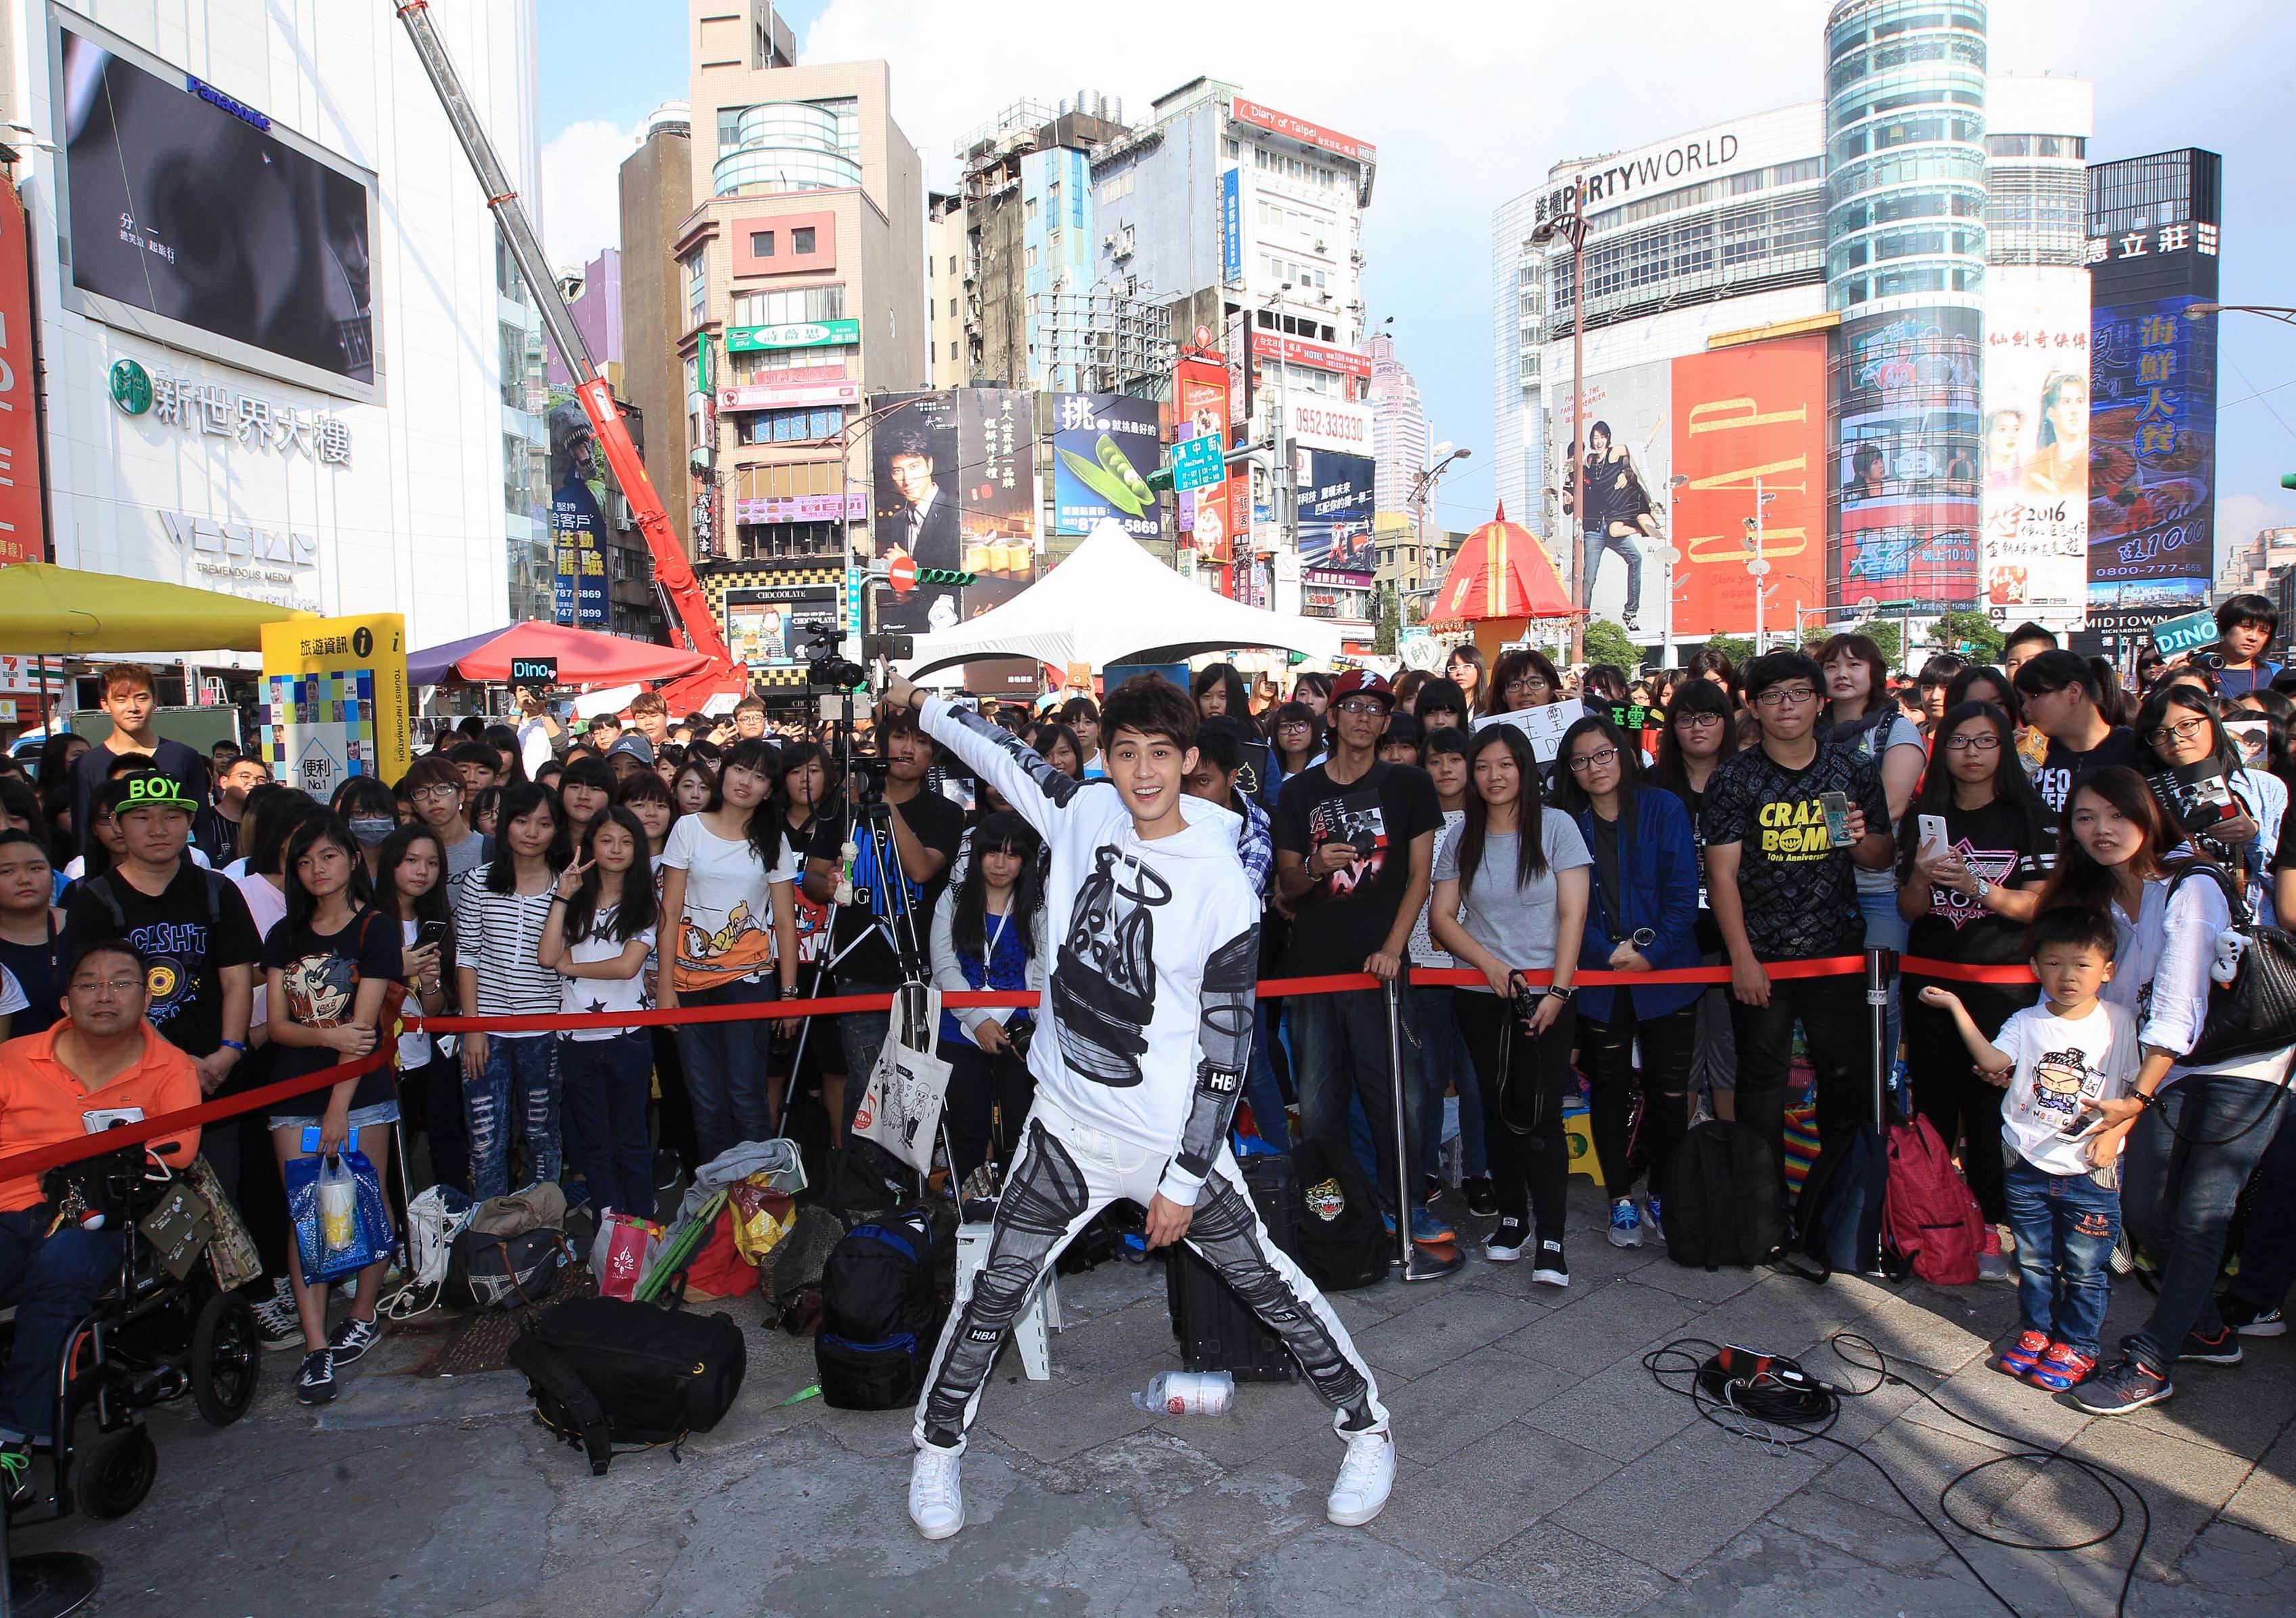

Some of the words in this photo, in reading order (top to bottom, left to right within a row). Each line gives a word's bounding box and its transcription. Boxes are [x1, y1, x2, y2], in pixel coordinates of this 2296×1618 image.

[187, 73, 271, 132] Panasonic
[1250, 104, 1276, 124] Diary
[1278, 117, 1288, 128] of
[1289, 118, 1317, 138] Taipei
[120, 212, 133, 230] 分
[2084, 224, 2190, 264] 德立莊
[1304, 349, 1324, 361] HOTEL
[1589, 385, 1599, 396] THE
[2135, 314, 2180, 457] 海鮮大餐
[155, 371, 352, 468] 新世界大樓
[1061, 395, 1095, 432] 挑
[1111, 418, 1157, 438] 就挑最好的
[1177, 436, 1217, 461] 漢中街
[1689, 396, 1808, 564] GAP
[556, 501, 576, 512] 堅持
[1297, 490, 1317, 506] 科技
[2026, 500, 2066, 522] 2016
[1061, 516, 1158, 536] (02)87-5869
[158, 510, 317, 565] WESTAR
[196, 562, 261, 580] TREMENDOUS
[265, 572, 293, 584] MEDIA
[2095, 563, 2201, 577] 0800-777-555
[2086, 614, 2167, 628] MIDTOWN
[300, 636, 348, 656] 旅遊資訊
[2101, 635, 2149, 647] 德立莊
[2155, 621, 2218, 653] DINO
[514, 662, 548, 677] Dino
[396, 707, 405, 762] INFORMATION
[302, 758, 331, 778] 便利
[129, 777, 181, 799] BOY
[308, 781, 327, 790] No.1
[1320, 801, 1337, 833] LUCY
[1333, 798, 1346, 820] MR.
[1759, 799, 1825, 827] CRAZ
[1762, 823, 1830, 852] BOM
[1767, 852, 1784, 862] 10th
[1786, 852, 1830, 862] Anniversar
[1210, 1071, 1237, 1092] HBA
[971, 1330, 996, 1341] HBA
